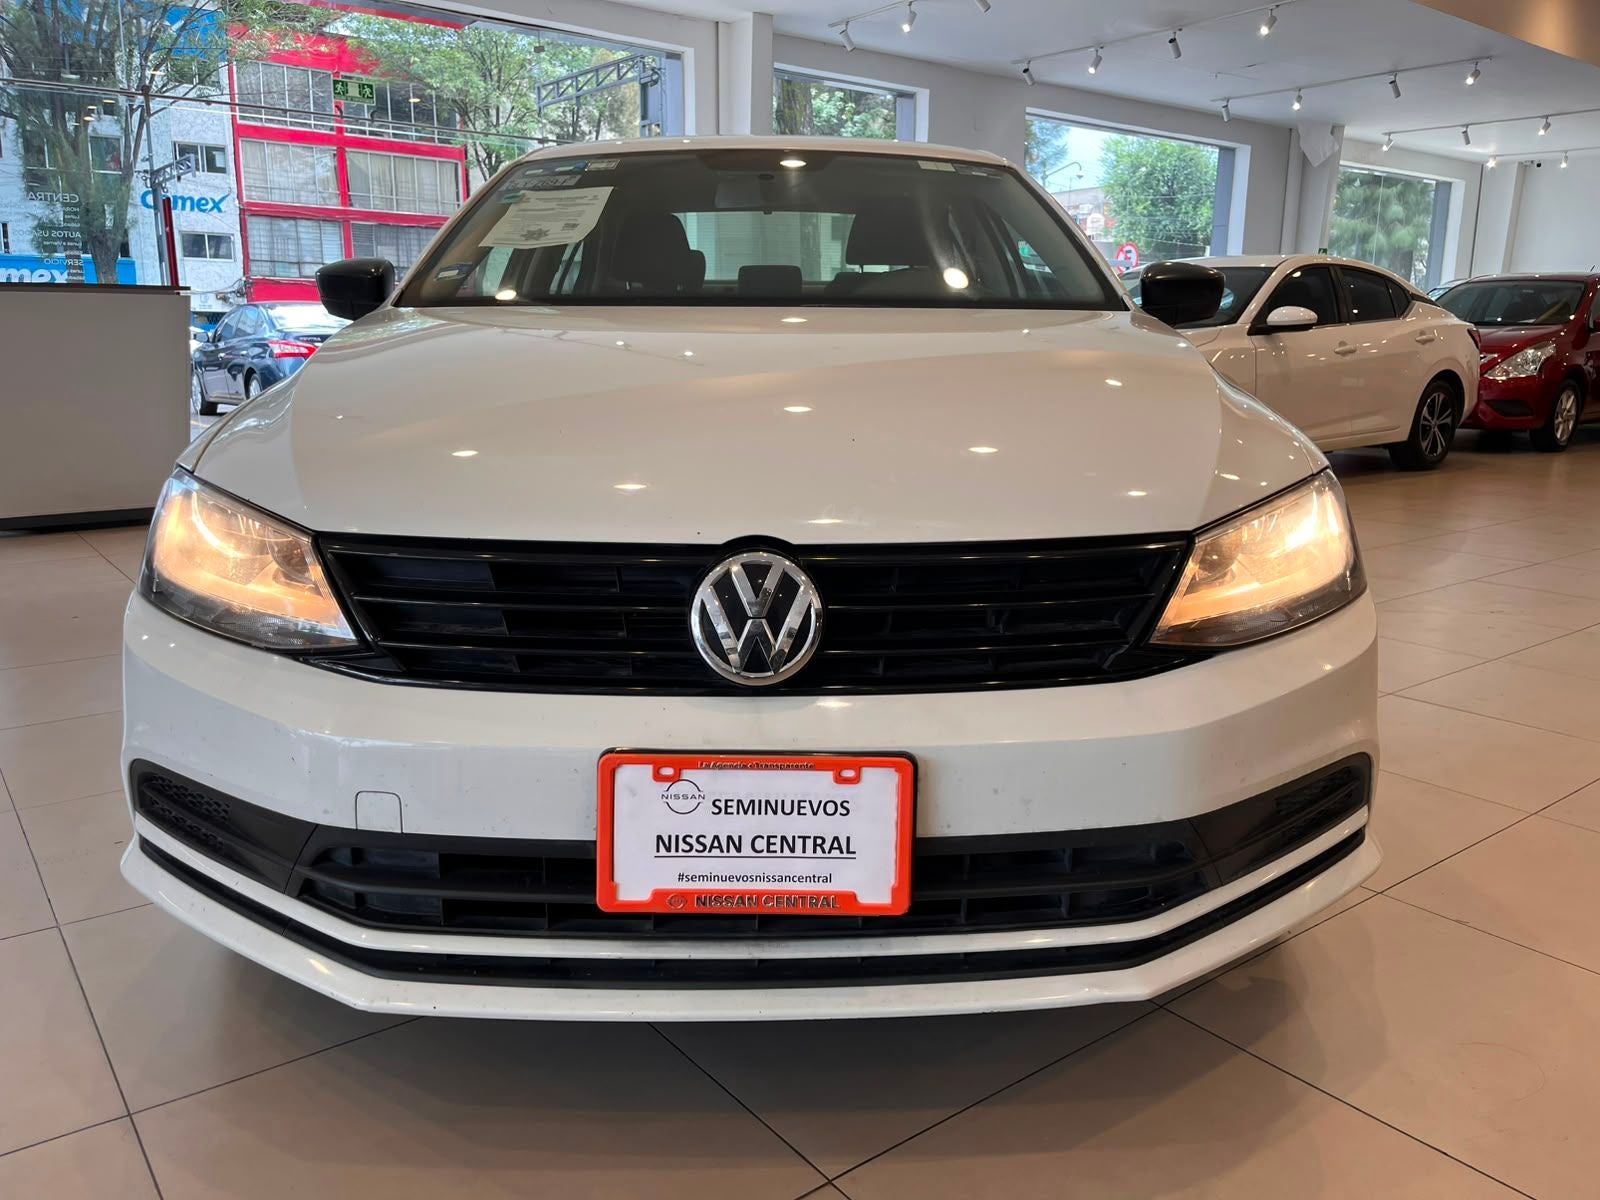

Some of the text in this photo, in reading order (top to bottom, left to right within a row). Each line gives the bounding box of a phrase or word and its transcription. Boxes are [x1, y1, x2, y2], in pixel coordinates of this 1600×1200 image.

[141, 189, 231, 213] Cmex
[661, 793, 706, 801] NISSAN
[711, 798, 851, 816] SEMINUEVOS
[655, 834, 857, 855] NISSAN CENTRAL
[677, 872, 832, 884] #seminuevosnissancentral
[694, 894, 840, 909] NISSAN CENTRAL
